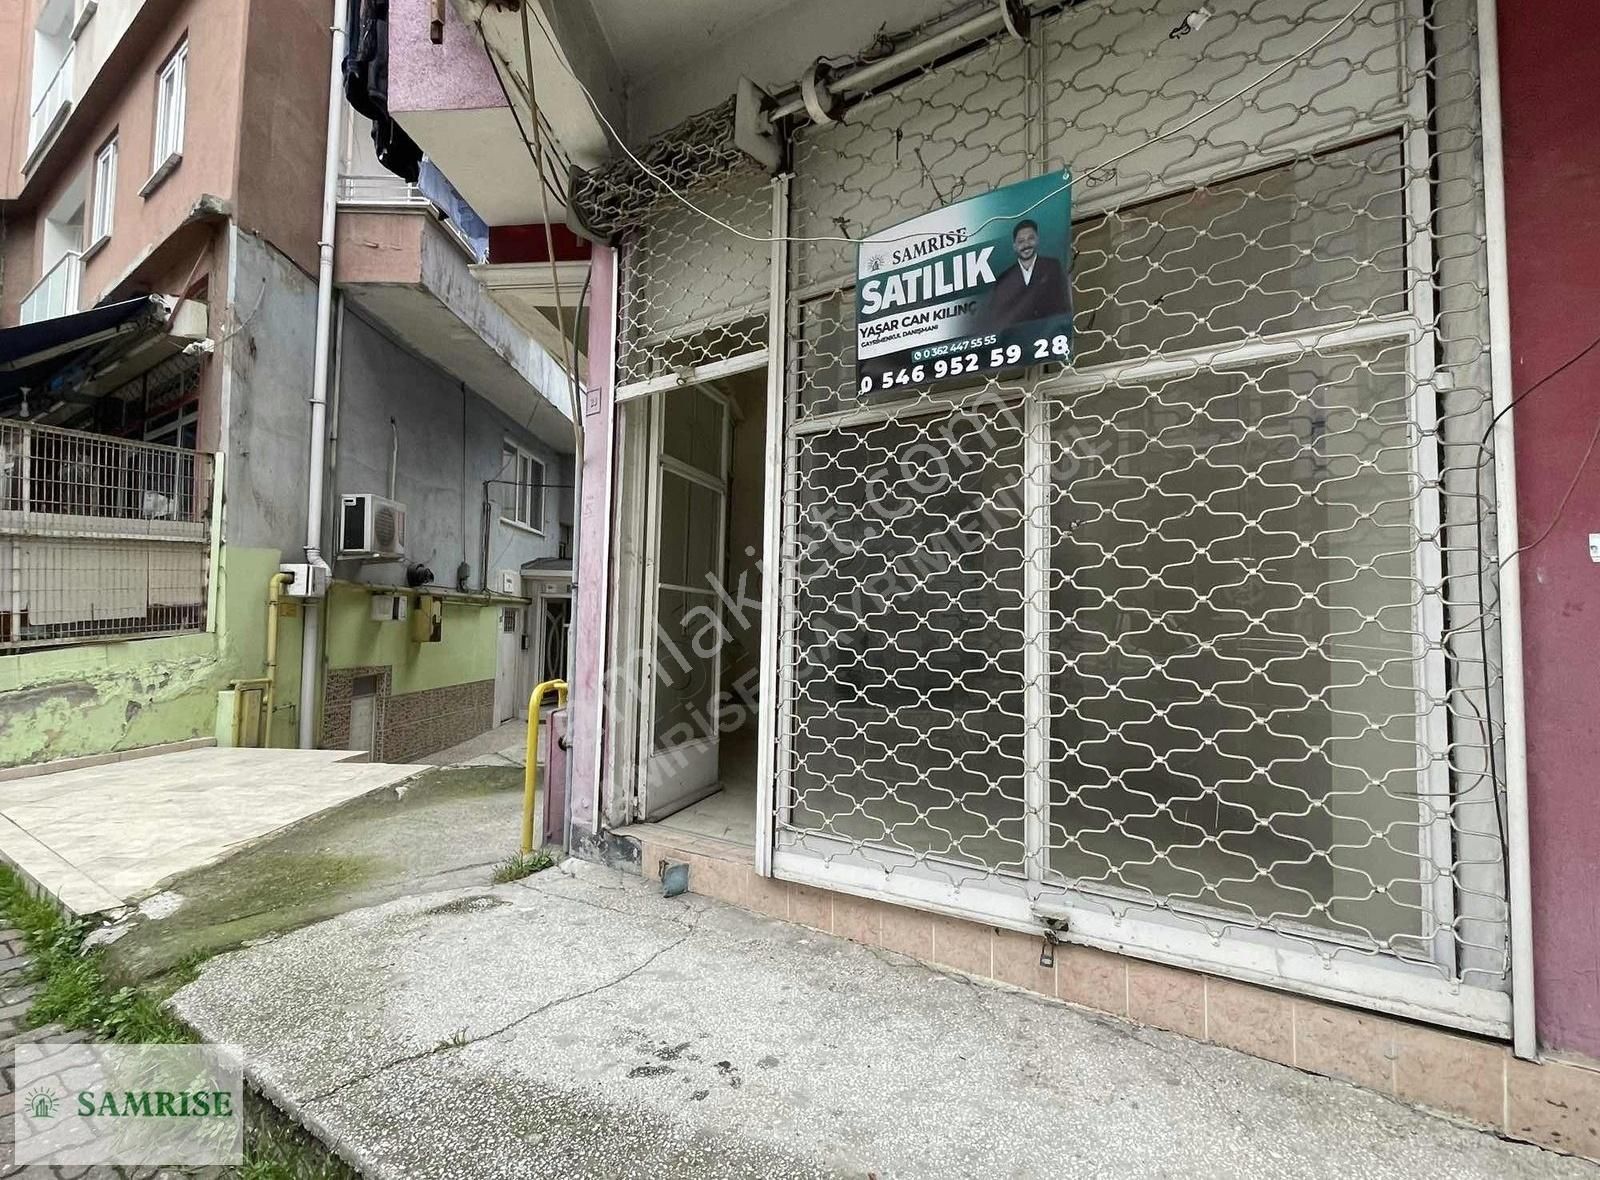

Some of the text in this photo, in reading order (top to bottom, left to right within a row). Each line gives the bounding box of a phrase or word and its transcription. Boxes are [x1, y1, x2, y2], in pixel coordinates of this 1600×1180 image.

[892, 227, 968, 265] SAMRISE
[861, 246, 996, 315] SATILIK
[860, 320, 899, 341] YAŞAR
[902, 312, 930, 327] CAN
[861, 335, 1069, 393] 0 546 952 59 28
[924, 334, 997, 358] 0 362 447 55 55
